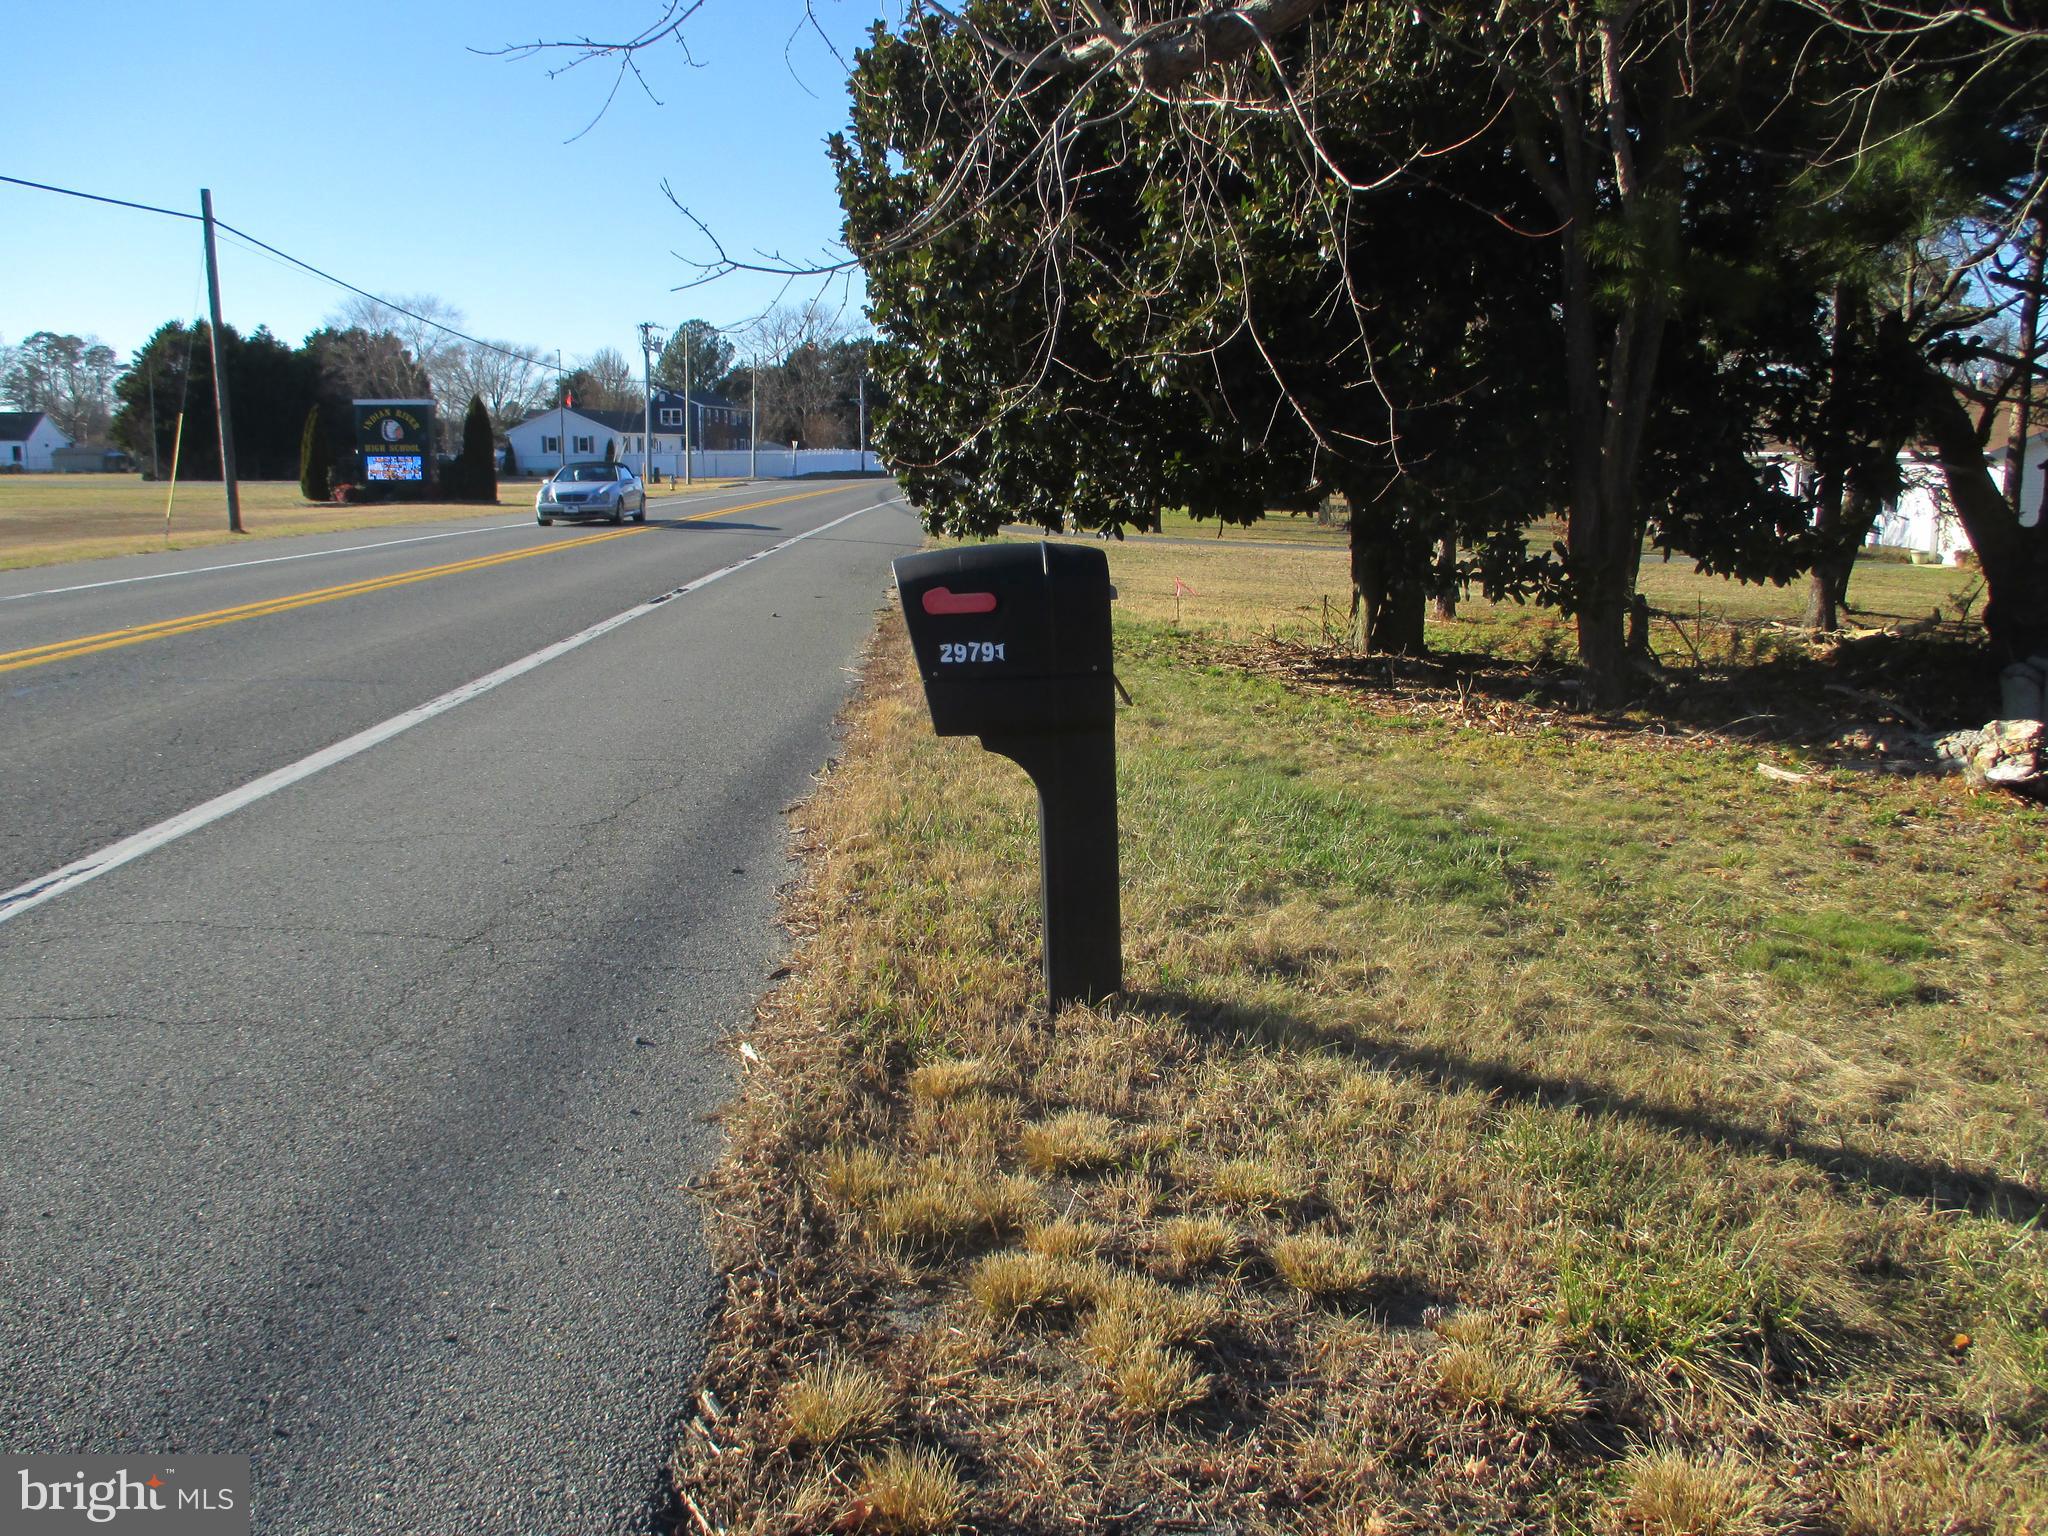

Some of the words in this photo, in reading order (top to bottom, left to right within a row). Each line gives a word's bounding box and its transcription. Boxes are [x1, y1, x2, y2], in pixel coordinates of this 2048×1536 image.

[363, 408, 391, 431] INDIAN
[395, 408, 421, 431] RIVER
[364, 444, 385, 452] HIGH
[389, 444, 421, 452] SCHOOL
[939, 641, 1005, 663] 29791
